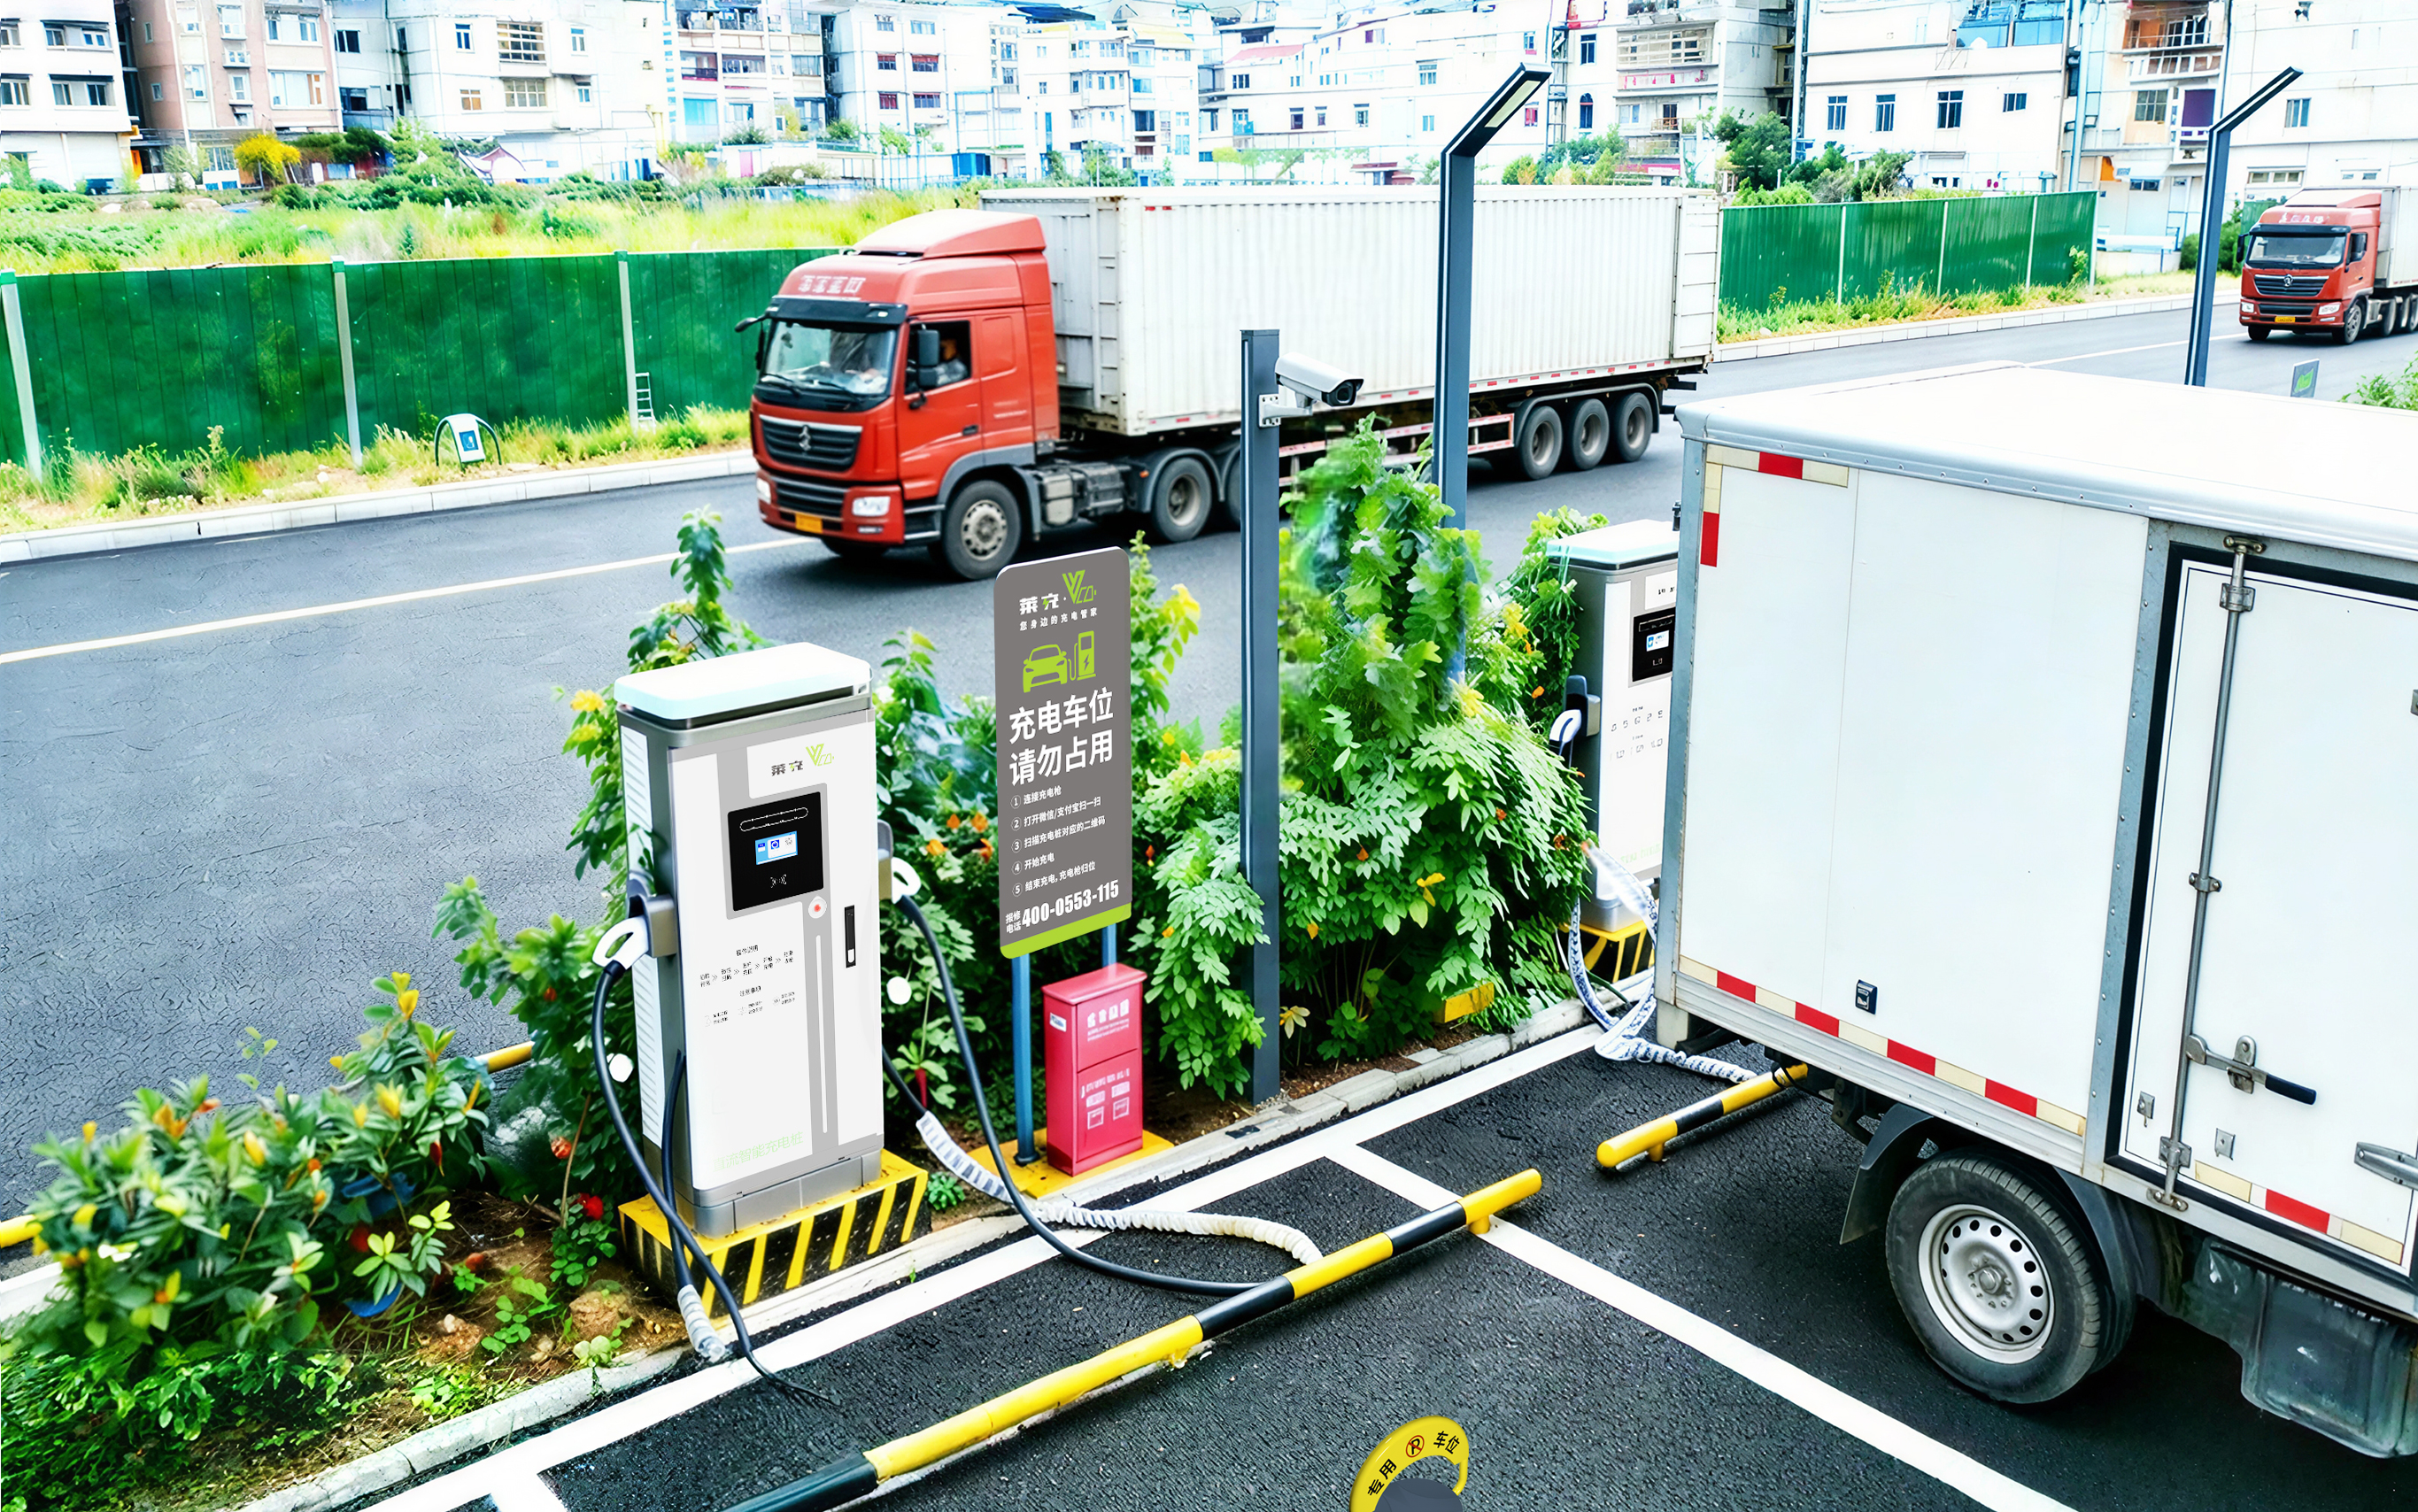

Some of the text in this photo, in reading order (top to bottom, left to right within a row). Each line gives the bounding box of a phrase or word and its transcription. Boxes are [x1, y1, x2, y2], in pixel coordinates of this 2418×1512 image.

[1019, 607, 1097, 631] 您身边的充电管家
[1009, 686, 1114, 744] 充电车位
[1009, 729, 1113, 787] 请勿占用
[1024, 785, 1062, 805] 连接充电枪
[1024, 796, 1101, 828] 打开微信/支付宝扫一扫
[1024, 814, 1106, 849] 扫描充电桩对应的二维码
[1024, 852, 1055, 870] 开始充电
[1006, 910, 1021, 924] 报修
[1022, 879, 1119, 928] 400-0553-115
[1006, 922, 1022, 934] 电话
[713, 1130, 804, 1172] 直流智能充电桩
[1367, 1458, 1397, 1496] 专用
[1433, 1431, 1460, 1454] 车位
